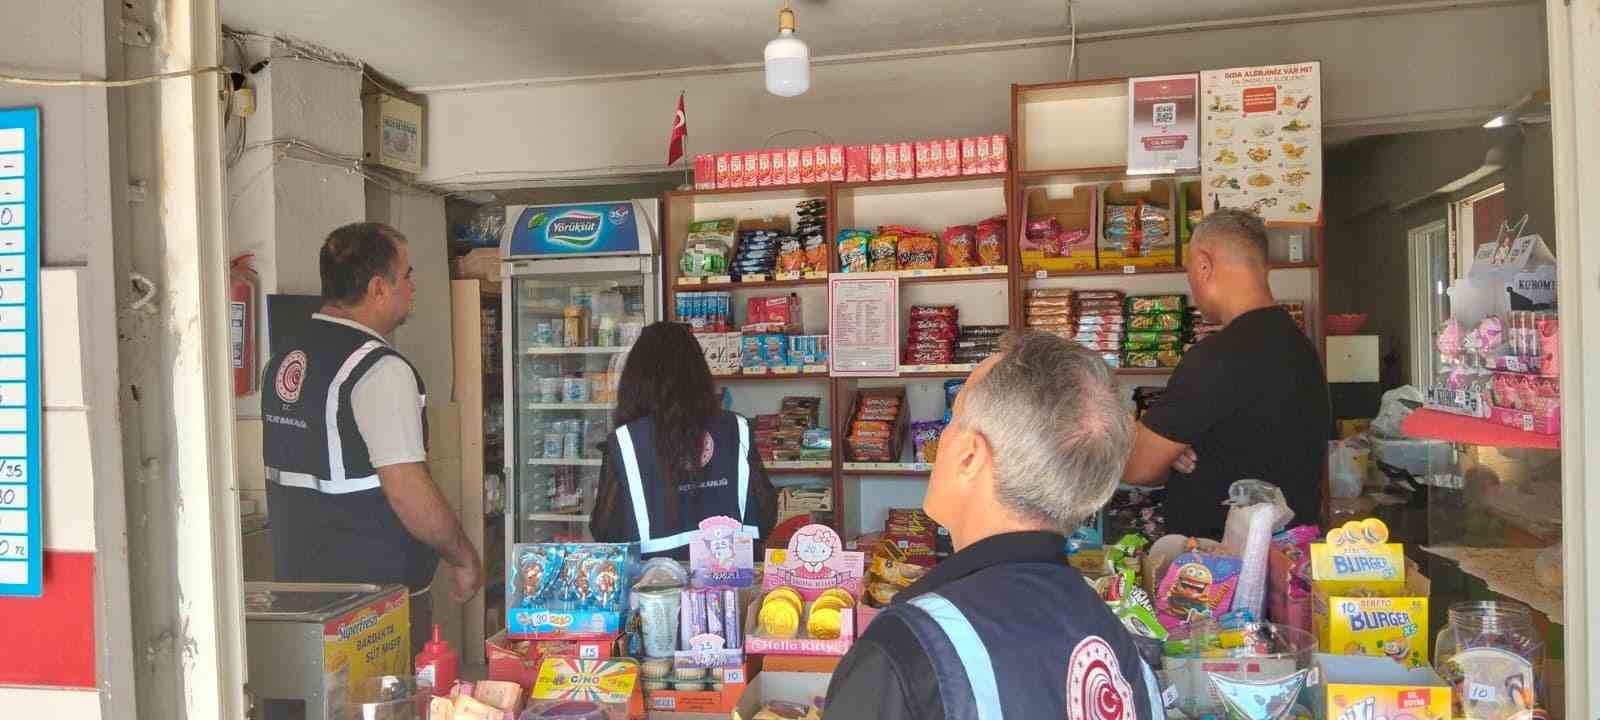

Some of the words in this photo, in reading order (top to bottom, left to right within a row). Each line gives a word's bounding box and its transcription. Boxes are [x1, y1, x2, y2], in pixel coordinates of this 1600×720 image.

[552, 221, 595, 233] Yörüksüt
[1333, 554, 1388, 574] BURGER
[1342, 602, 1356, 614] 10
[1350, 611, 1411, 632] BURGER
[762, 640, 799, 651] Hello
[801, 639, 834, 651] Kitty
[583, 647, 597, 657] 15
[727, 672, 739, 681] 10
[1471, 685, 1488, 698] 10
